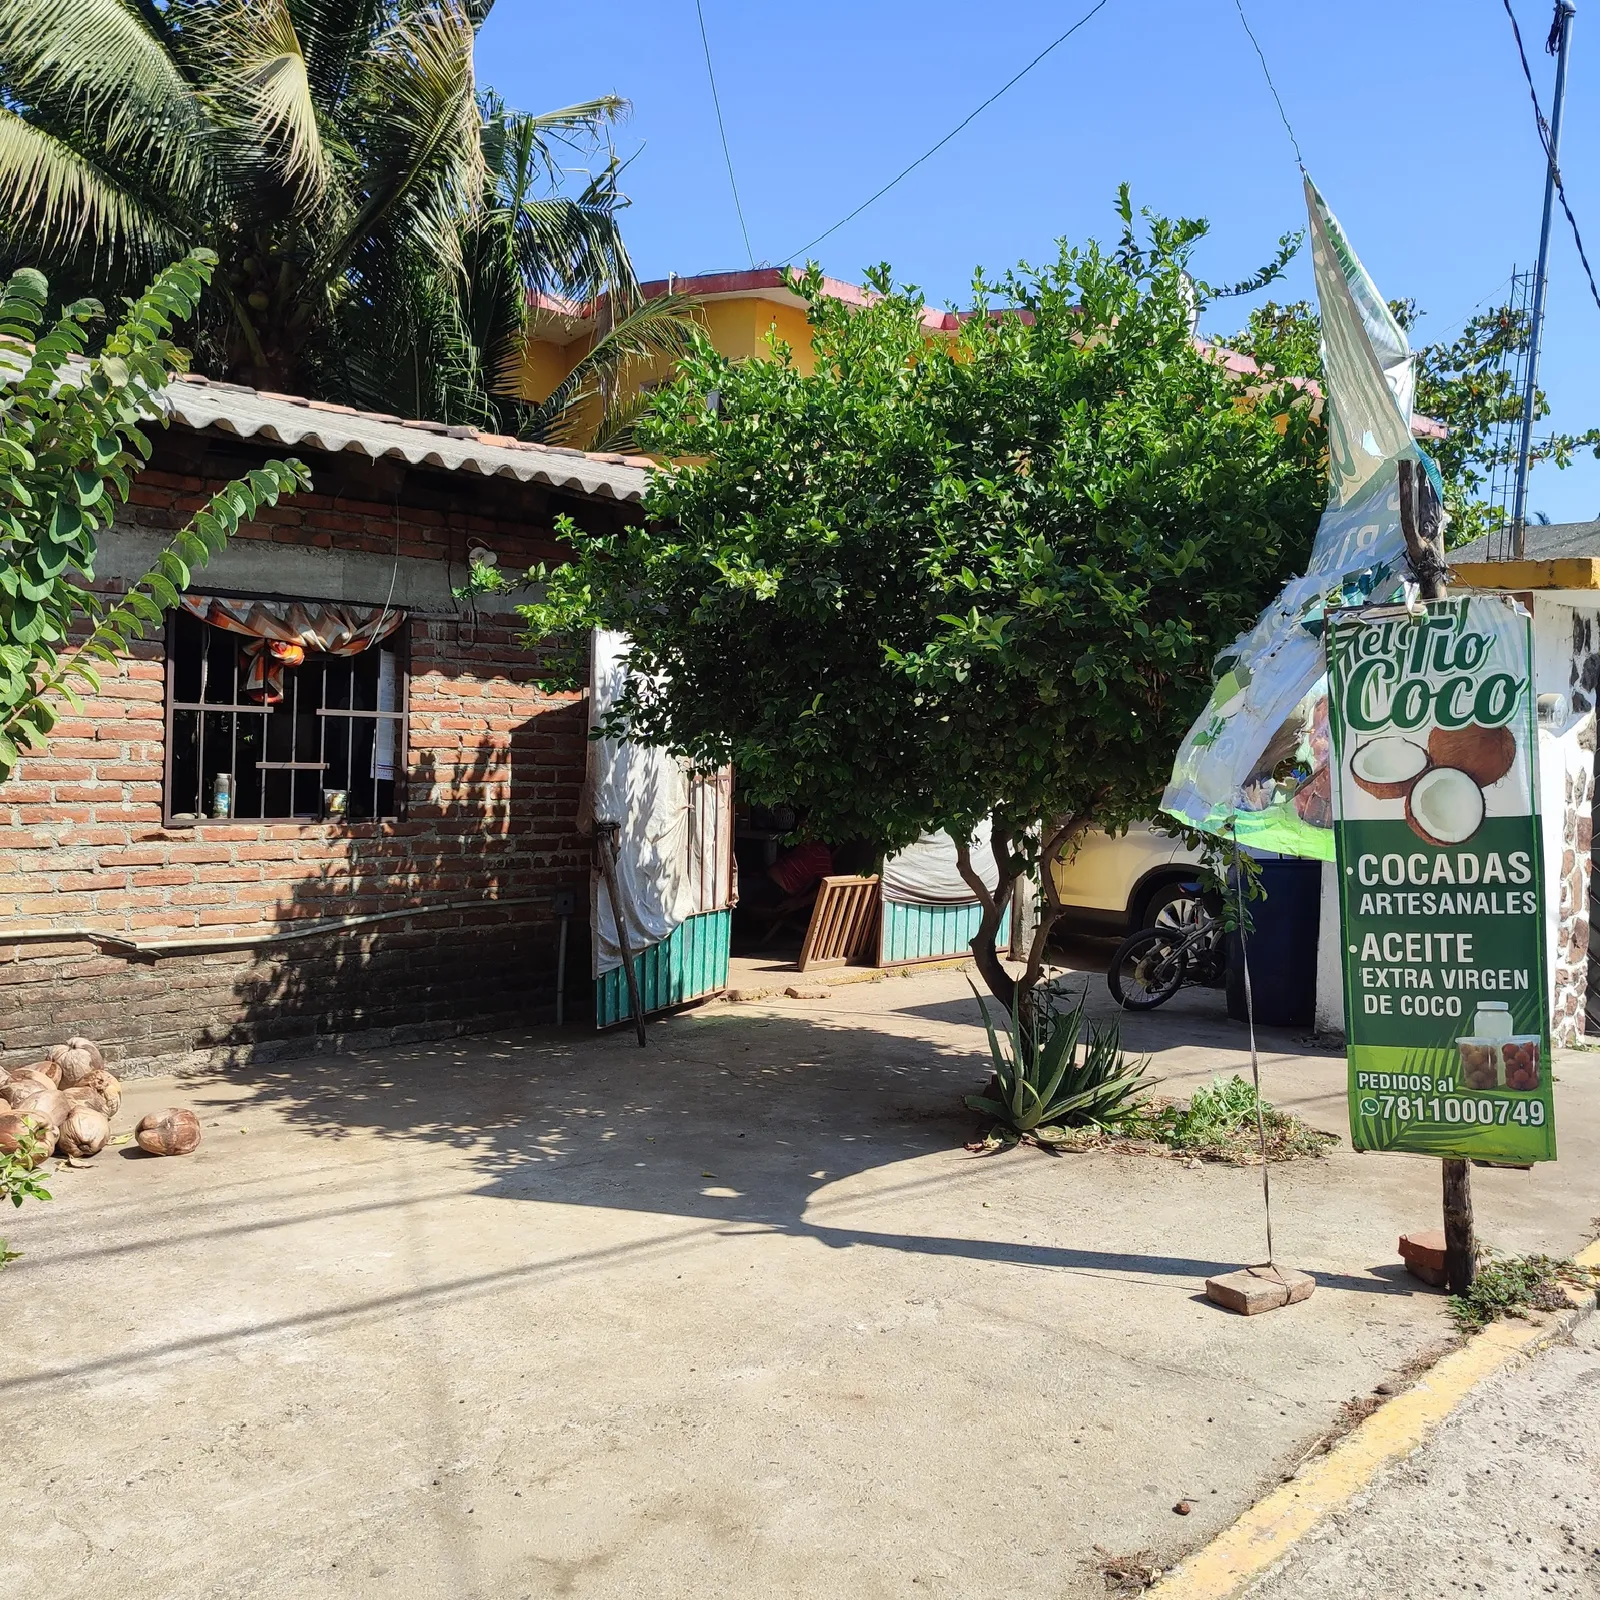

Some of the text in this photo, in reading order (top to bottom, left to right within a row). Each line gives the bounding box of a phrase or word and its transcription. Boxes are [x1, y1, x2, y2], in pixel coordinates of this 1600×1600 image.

[1363, 622, 1392, 655] el
[1346, 658, 1526, 731] Coco
[1357, 851, 1532, 886] COCADAS
[1358, 891, 1537, 915] ARTESANALES
[1360, 932, 1474, 964] ACEITE
[1362, 967, 1529, 990] EXTRA VIRGEN
[1363, 995, 1462, 1017] DE COCO
[1358, 1072, 1454, 1093] PEDIDOS al
[1378, 1095, 1545, 1125] 7811000749
